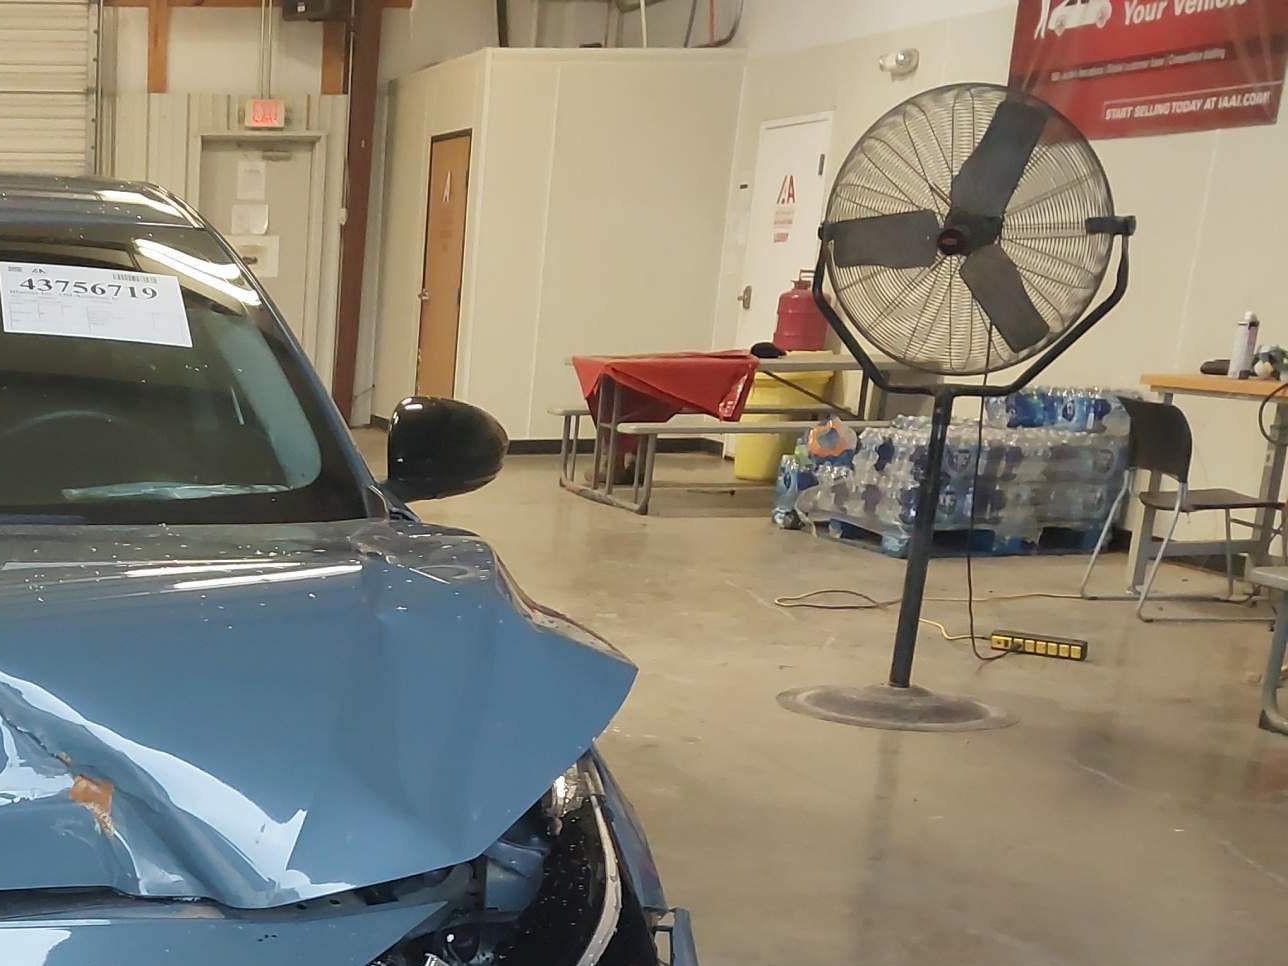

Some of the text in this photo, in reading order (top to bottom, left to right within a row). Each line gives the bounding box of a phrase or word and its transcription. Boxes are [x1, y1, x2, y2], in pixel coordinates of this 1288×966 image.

[1124, 0, 1247, 26] Your Vehic
[1204, 97, 1217, 111] AT
[19, 277, 158, 300] 43756719
